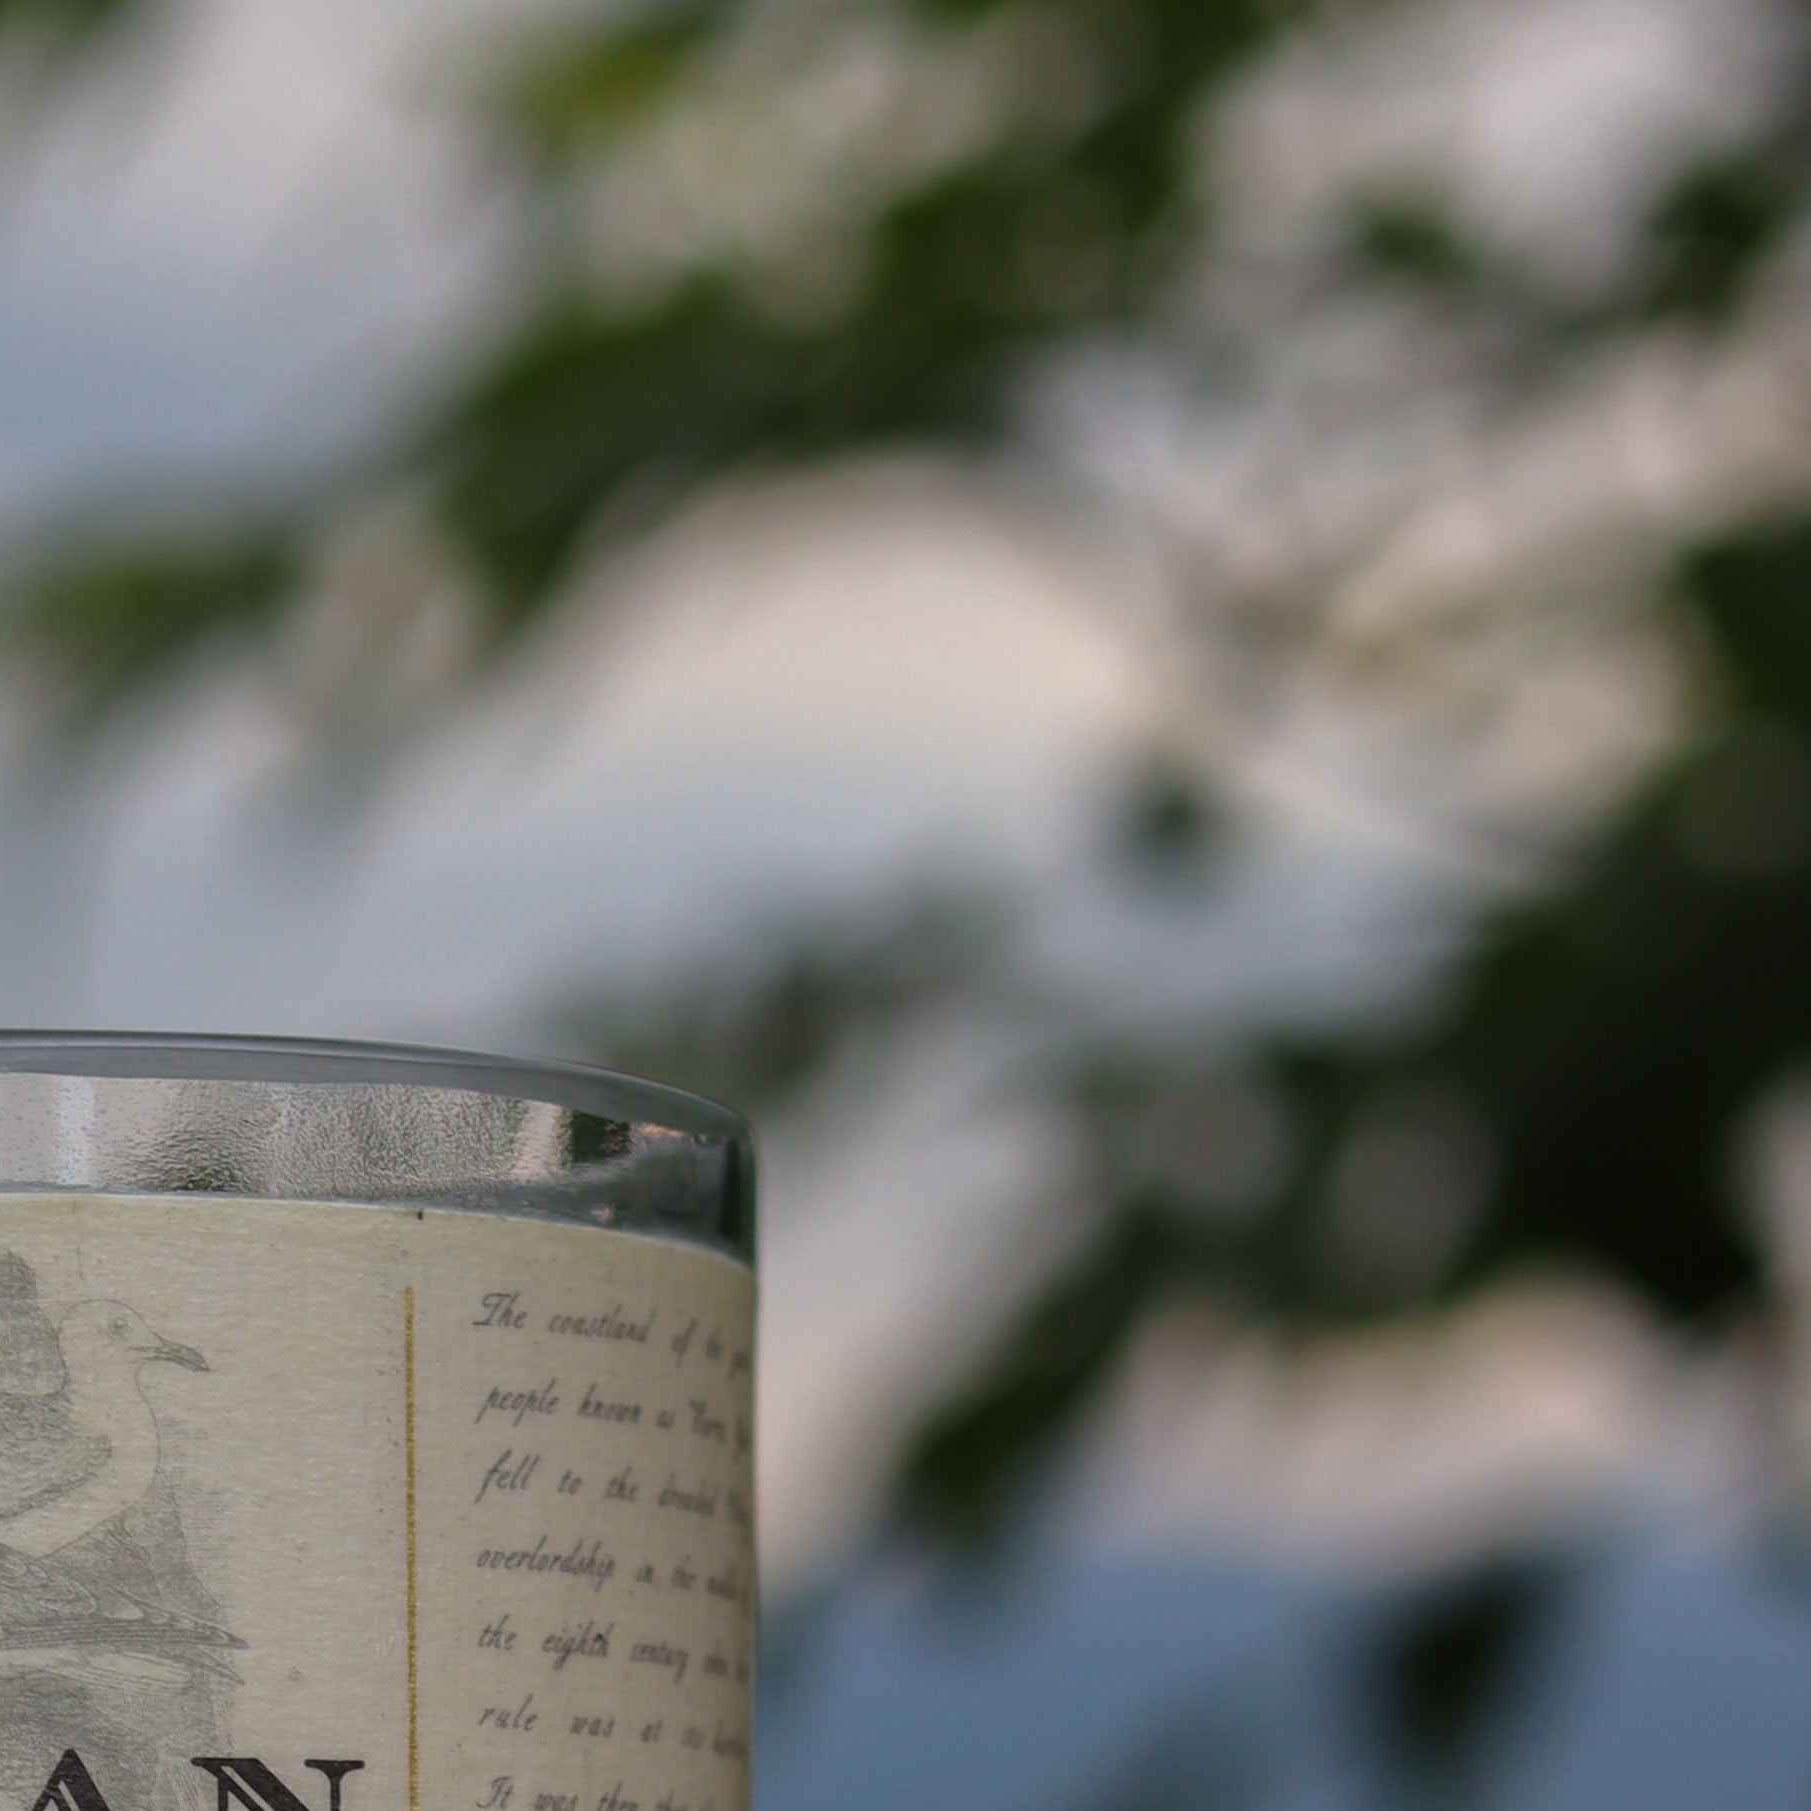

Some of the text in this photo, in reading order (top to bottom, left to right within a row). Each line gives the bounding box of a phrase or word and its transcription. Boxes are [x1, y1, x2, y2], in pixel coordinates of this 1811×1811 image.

[473, 1291, 528, 1330] The
[474, 1377, 641, 1427] people known
[474, 1449, 639, 1504] fell to the
[478, 1534, 615, 1592] overlordship
[478, 1614, 516, 1651] the
[478, 1693, 615, 1738] rule was
[477, 1776, 514, 1810] It
